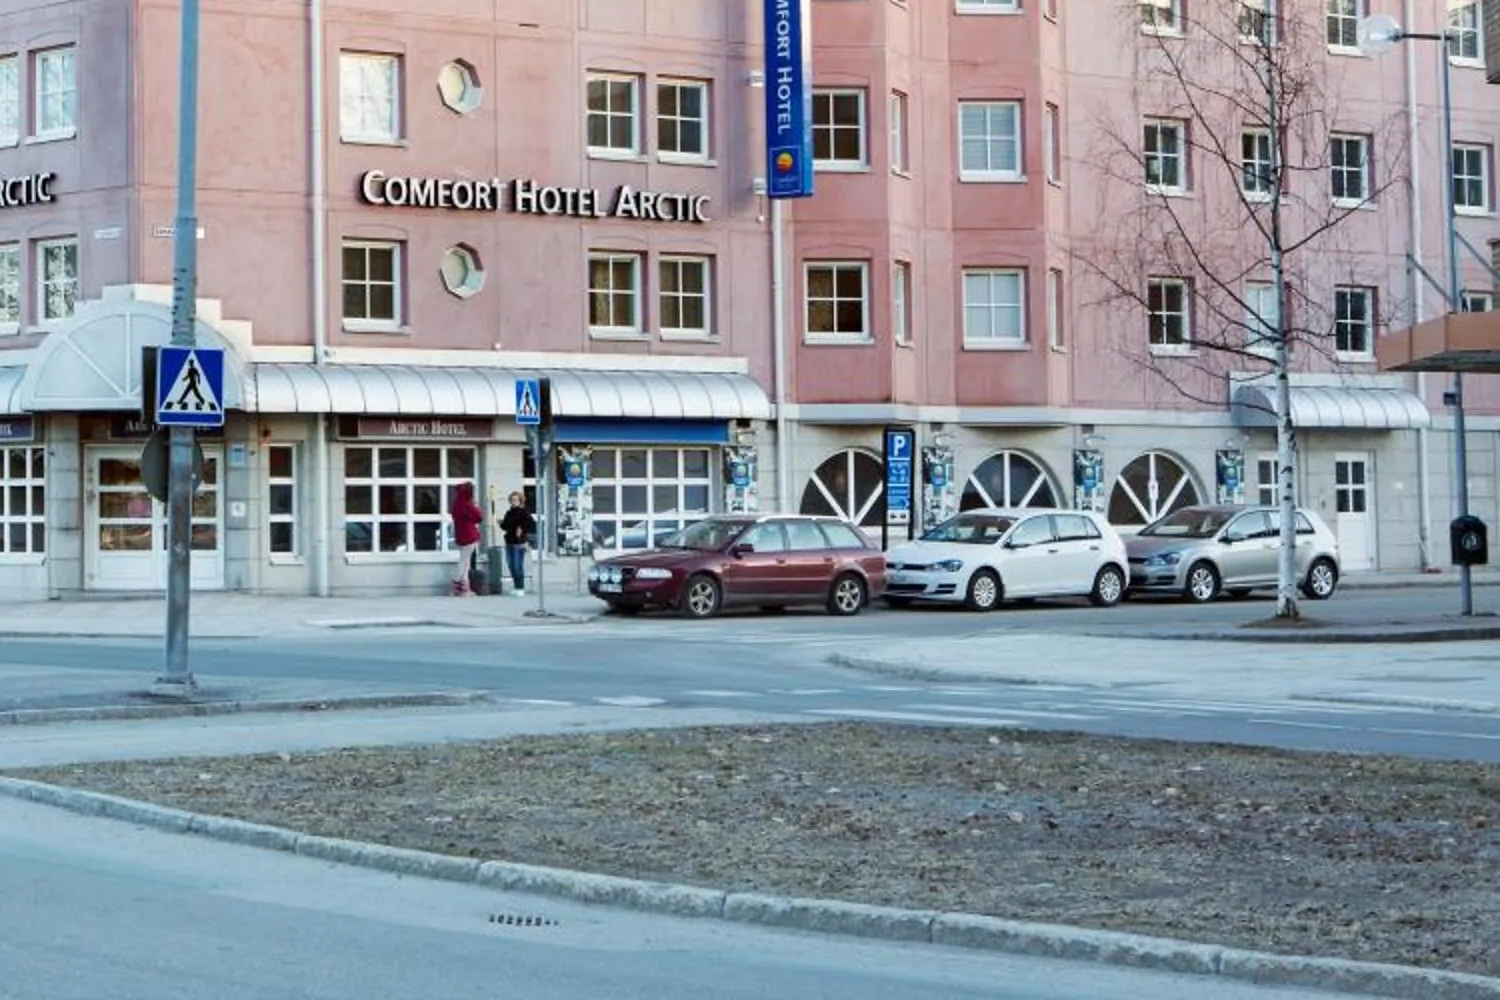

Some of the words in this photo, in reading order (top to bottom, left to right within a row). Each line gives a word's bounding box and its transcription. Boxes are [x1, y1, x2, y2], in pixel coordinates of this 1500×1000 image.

[777, 66, 793, 135] HOTEL
[362, 169, 508, 210] COMFORT
[515, 179, 606, 217] HOTEL
[614, 185, 712, 222] ARCTIC
[893, 435, 906, 456] P
